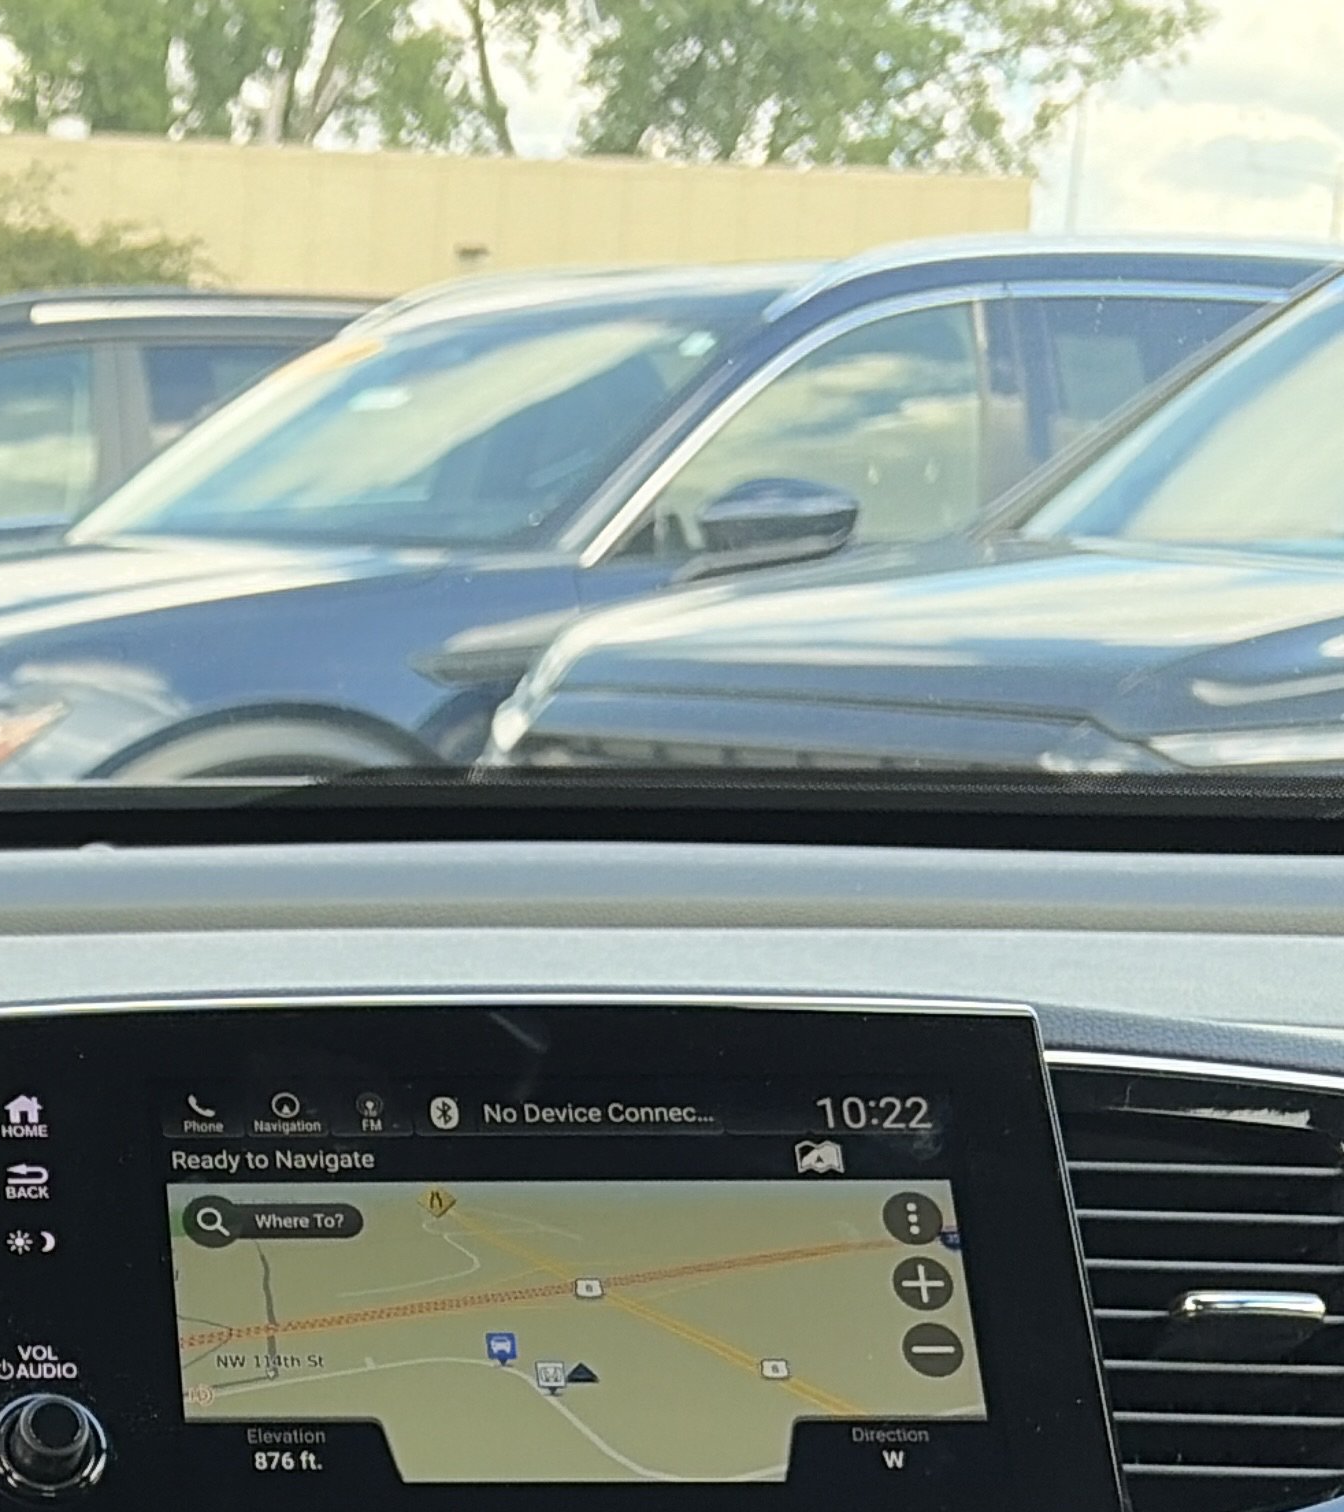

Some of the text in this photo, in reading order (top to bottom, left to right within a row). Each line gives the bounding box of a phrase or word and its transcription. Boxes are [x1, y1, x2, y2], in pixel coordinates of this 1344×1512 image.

[483, 1103, 517, 1123] No
[524, 1103, 602, 1123] Device
[816, 1096, 933, 1129] 10:22
[1, 1125, 49, 1138] HOME
[183, 1119, 224, 1133] Phone
[254, 1119, 322, 1134] Navigation
[362, 1118, 383, 1132] FM
[171, 1149, 376, 1173] Ready to Navigate
[5, 1186, 50, 1200] BACK
[255, 1213, 344, 1229] Where To?
[17, 1345, 58, 1361] VOL
[216, 1354, 324, 1369] NW 114th St
[16, 1362, 78, 1380] AUDIO
[247, 1429, 326, 1445] Elevation
[852, 1427, 930, 1443] Direction
[254, 1450, 323, 1471] 876 ft.
[882, 1449, 904, 1469] W
